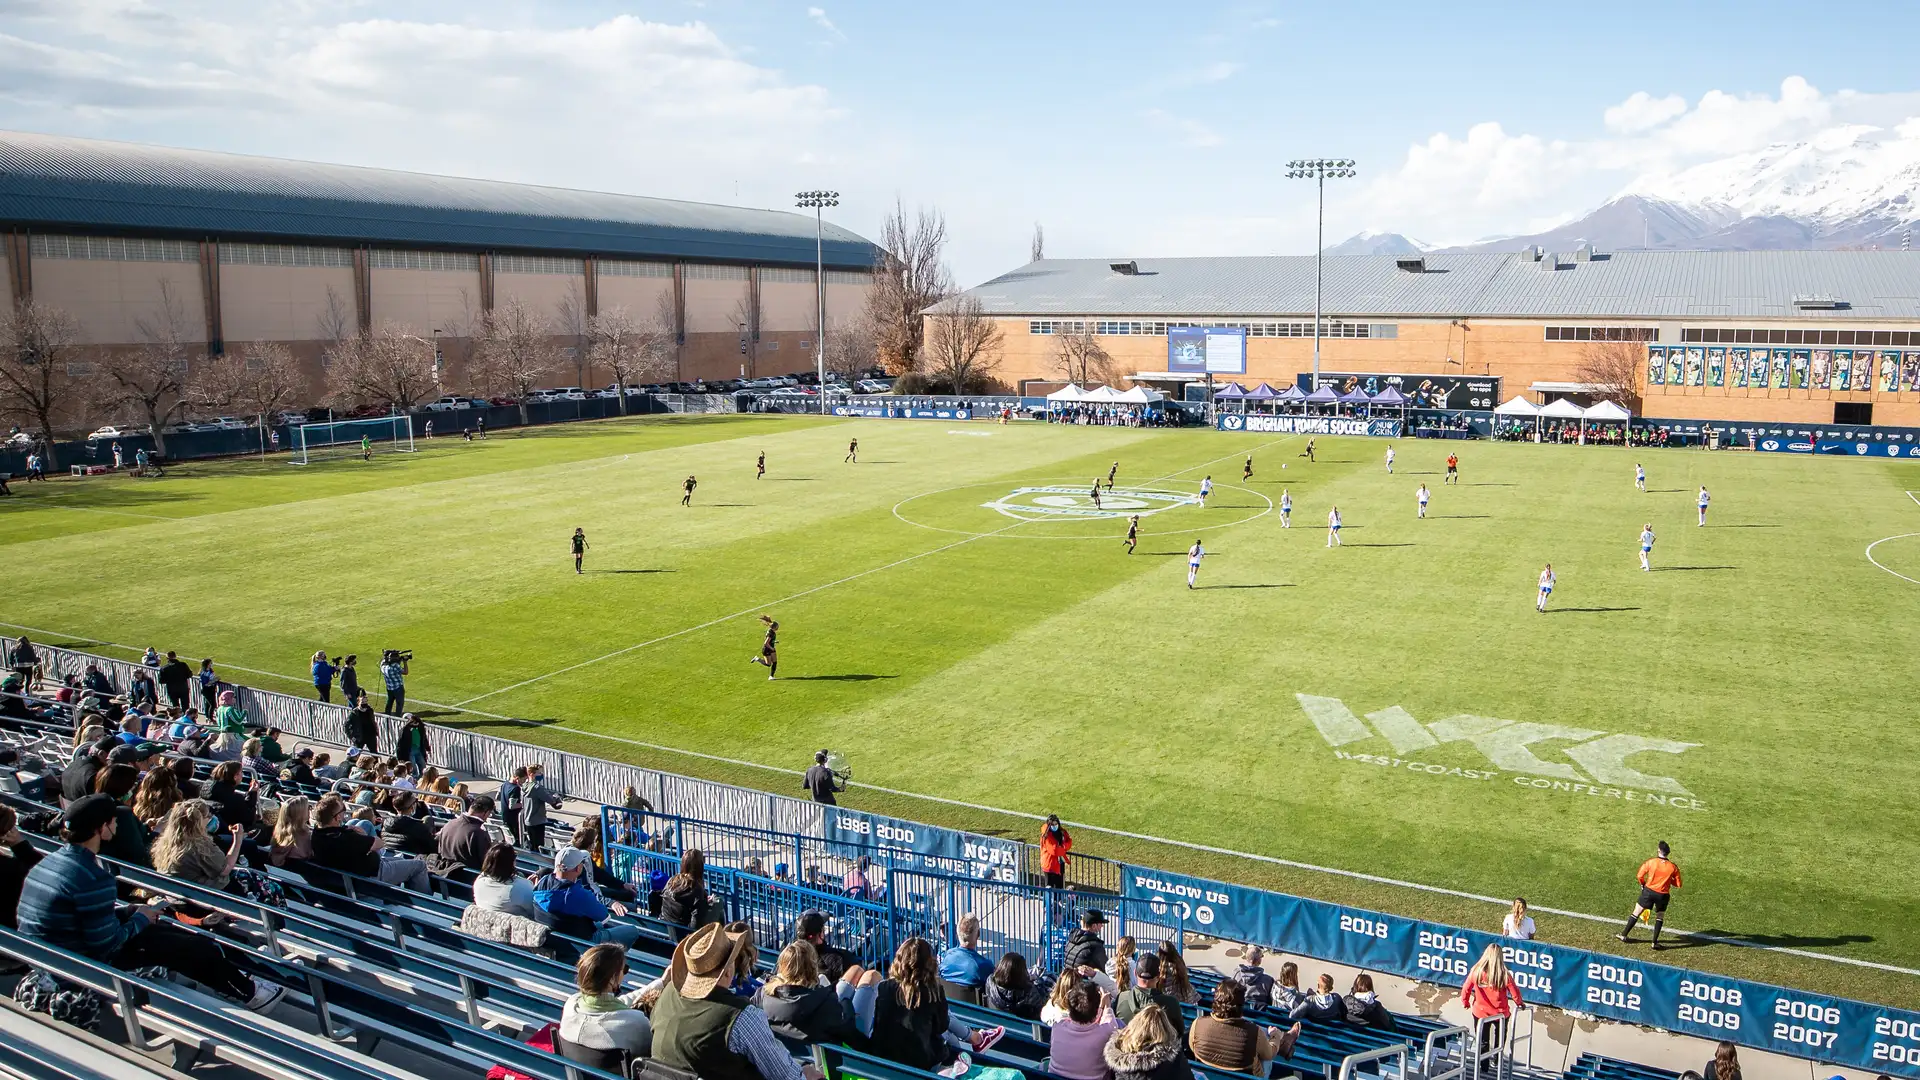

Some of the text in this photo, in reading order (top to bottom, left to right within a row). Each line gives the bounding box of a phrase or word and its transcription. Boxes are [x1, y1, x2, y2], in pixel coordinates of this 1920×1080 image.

[1246, 416, 1293, 431] BRIGHAM
[1294, 418, 1329, 433] YOUNG
[1330, 419, 1369, 435] SOCCER
[1296, 692, 1704, 797] WCC
[1407, 762, 1498, 781] COAST
[1513, 776, 1707, 812] CONFERENCE
[836, 816, 915, 844] 1998 2000
[964, 842, 1015, 865] NCAA
[992, 868, 1015, 883] 16
[1135, 876, 1229, 906] FOLLOW US
[1340, 915, 1388, 939] 2018
[1418, 931, 1469, 954] 2015
[1417, 952, 1468, 976] 2016
[1502, 946, 1553, 970] 2013
[1508, 970, 1552, 993] 014
[1587, 962, 1643, 988] 2010
[1586, 986, 1641, 1012] 2012
[1679, 980, 1742, 1007] 2008
[1678, 1003, 1740, 1030] 2009
[1774, 998, 1840, 1025] 2006
[1773, 1022, 1838, 1049] 2007
